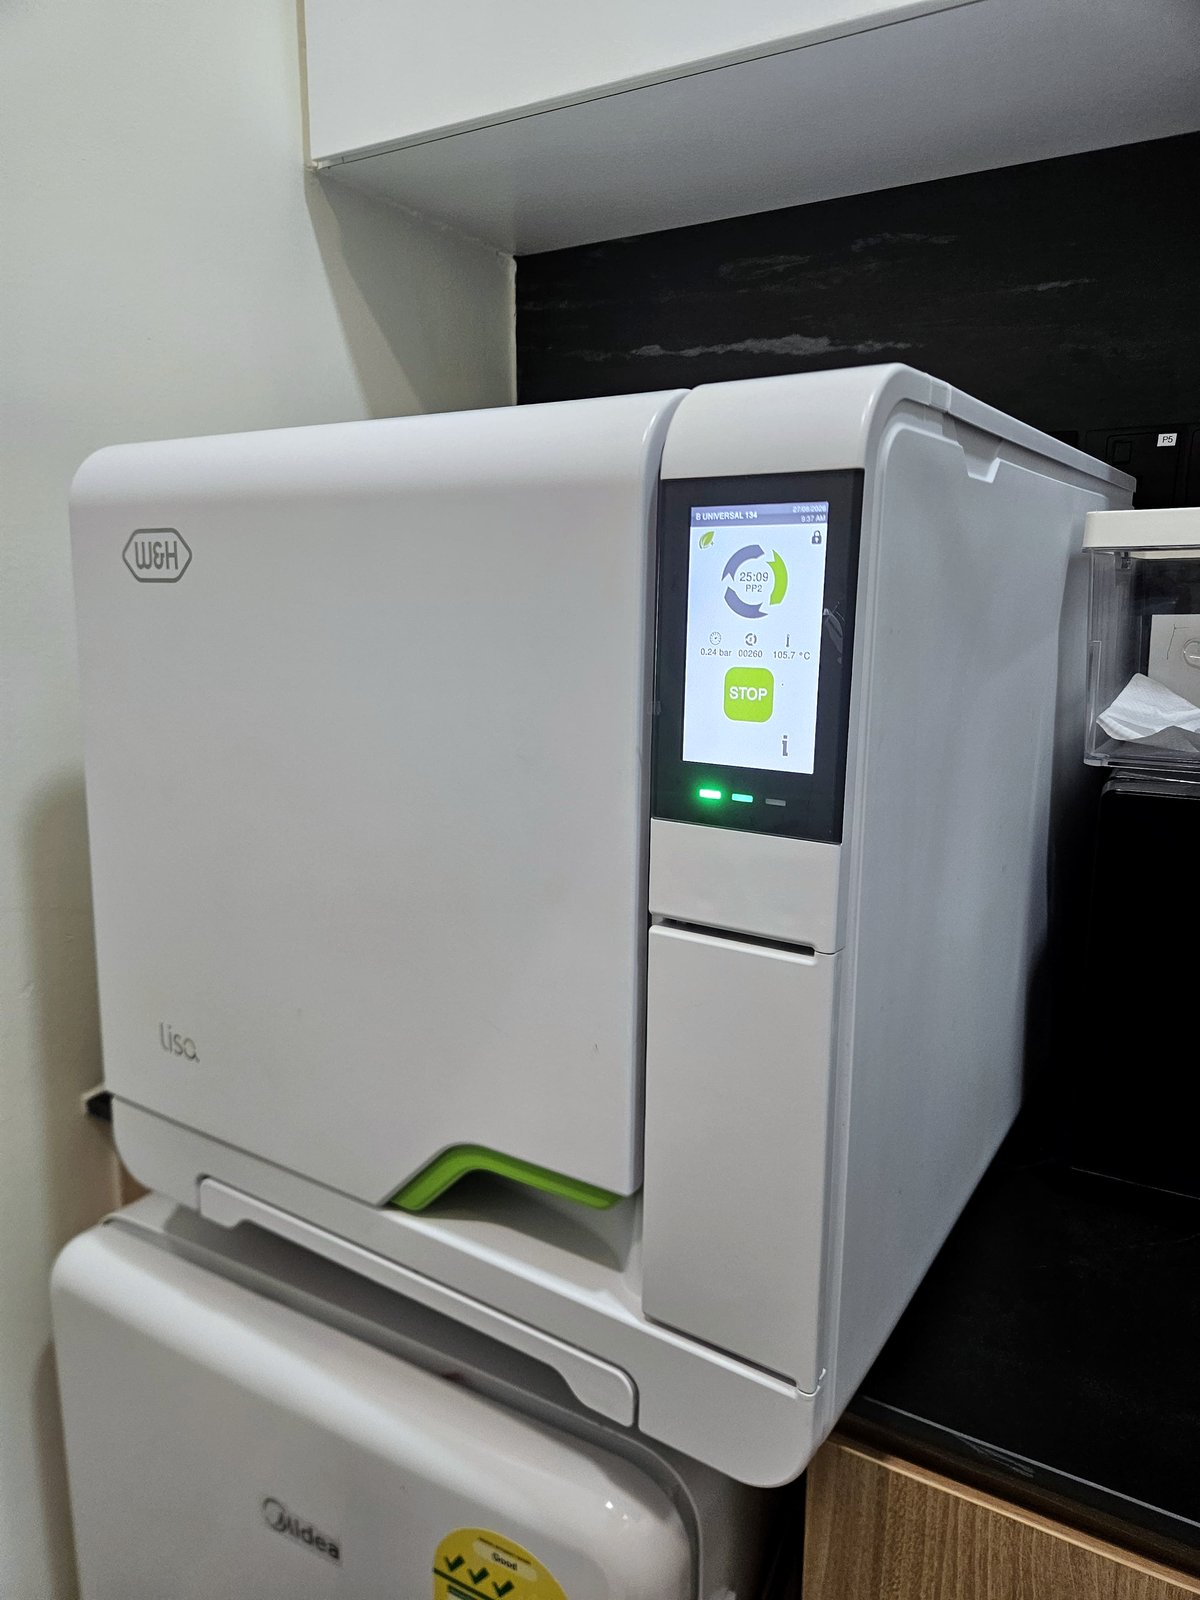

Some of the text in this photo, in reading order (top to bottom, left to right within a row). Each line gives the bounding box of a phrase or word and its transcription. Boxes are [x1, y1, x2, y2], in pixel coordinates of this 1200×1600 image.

[702, 512, 744, 520] UNIVERSAL
[746, 511, 757, 519] 134
[815, 514, 826, 522] AM
[134, 541, 178, 570] W&H
[740, 572, 768, 582] 25:09
[746, 584, 762, 592] PP2
[700, 648, 716, 656] 0.24
[738, 650, 762, 658] 00260
[773, 651, 810, 660] 105.7 °C
[729, 687, 768, 701] STOP
[262, 1498, 340, 1559] Midea
[492, 1552, 518, 1571] Good
